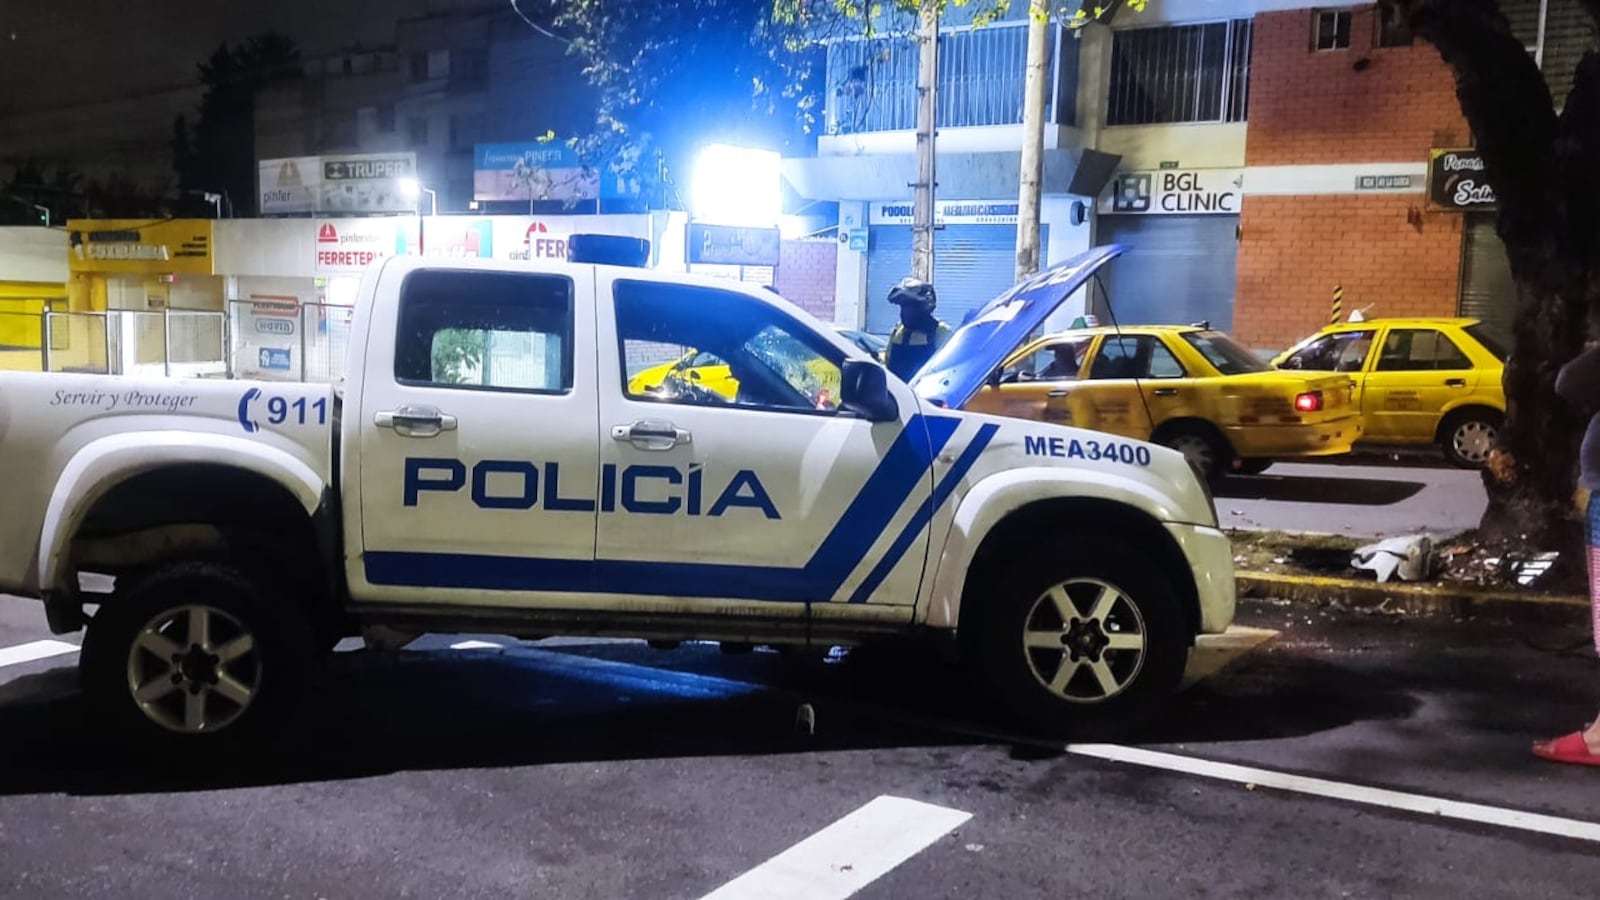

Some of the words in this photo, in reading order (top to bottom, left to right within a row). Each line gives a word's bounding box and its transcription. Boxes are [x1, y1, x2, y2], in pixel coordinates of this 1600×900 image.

[1163, 173, 1203, 192] BGL
[1161, 192, 1234, 212] CLINIC
[318, 251, 384, 266] FERRETER
[50, 389, 105, 406] Servir
[105, 392, 119, 411] y
[122, 389, 198, 412] Proteger
[267, 395, 327, 425] 911
[1024, 435, 1151, 467] MEA3400
[403, 457, 782, 520] POLICÍA
